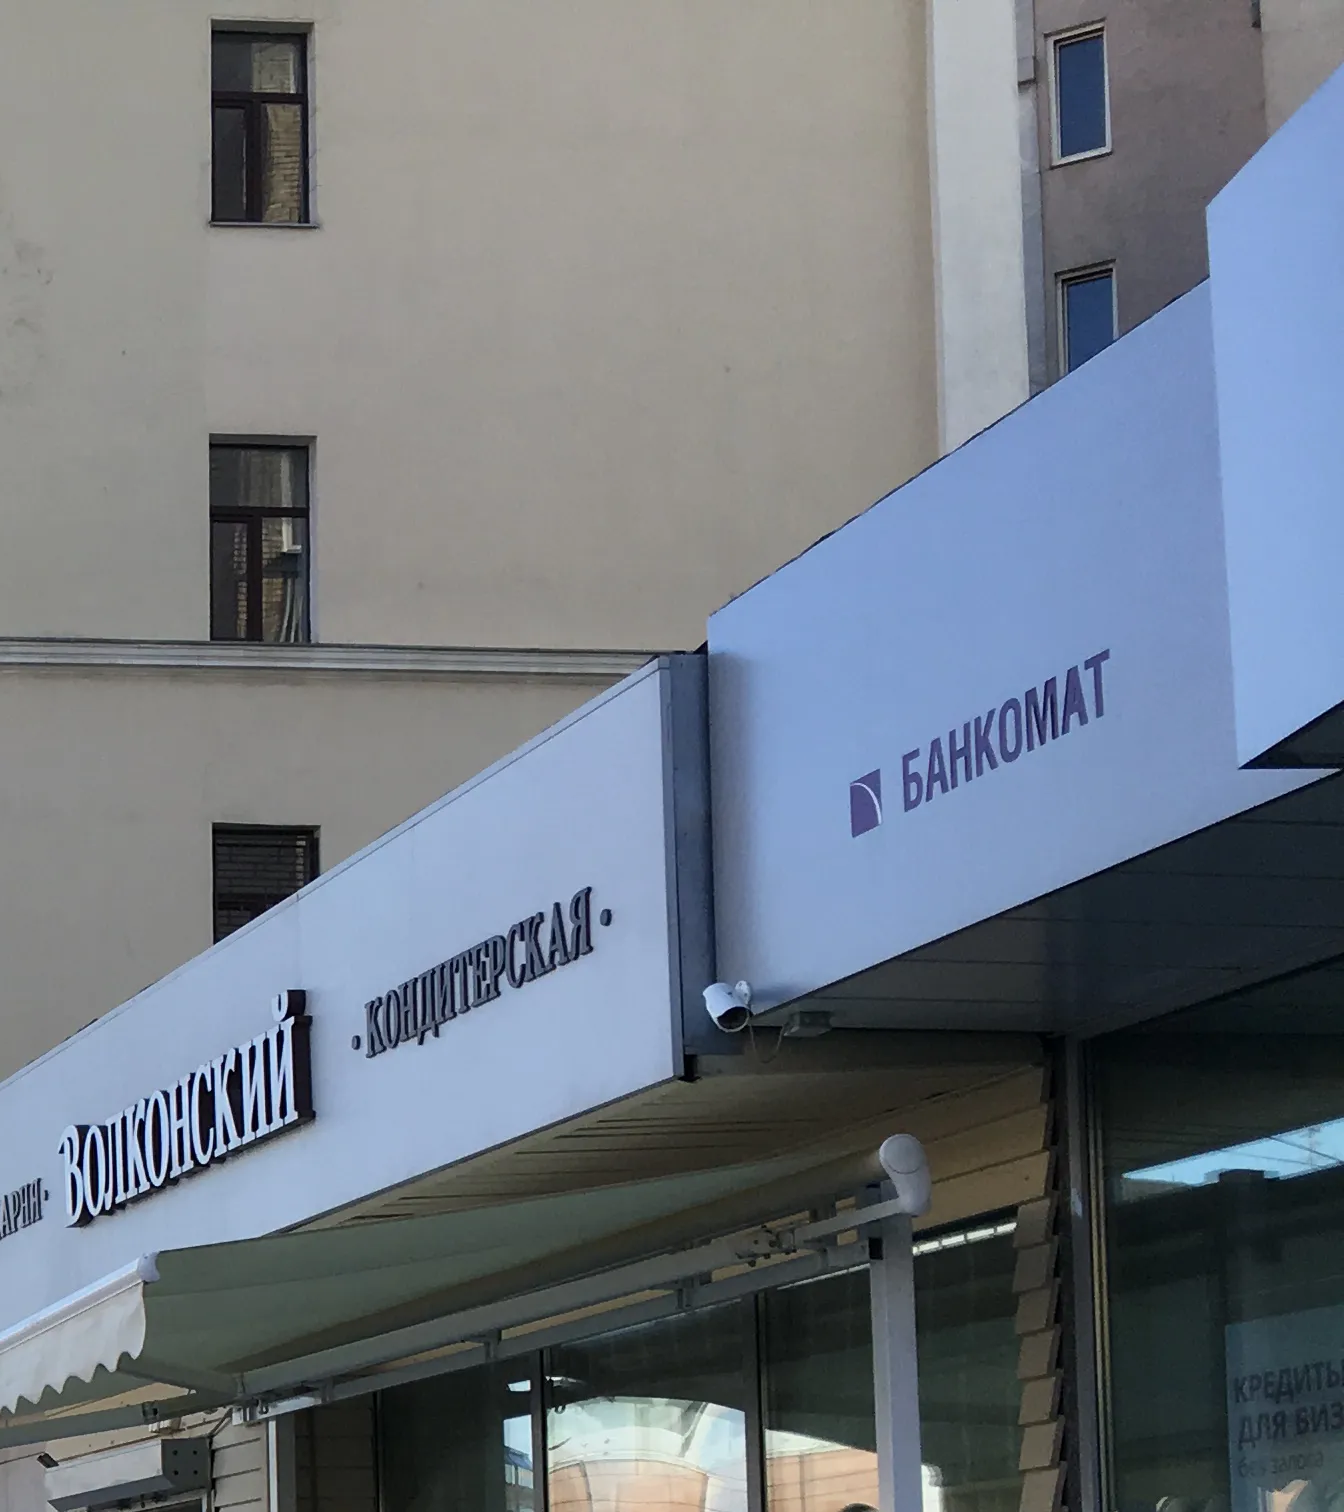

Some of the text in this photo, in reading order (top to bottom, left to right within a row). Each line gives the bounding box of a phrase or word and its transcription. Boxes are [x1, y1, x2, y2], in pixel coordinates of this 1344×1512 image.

[901, 648, 1111, 813] БАНКОМАТ
[363, 886, 595, 1059] КОНДИТЕРСКАЯ
[57, 988, 315, 1229] ВОЛКОНСКИЙ
